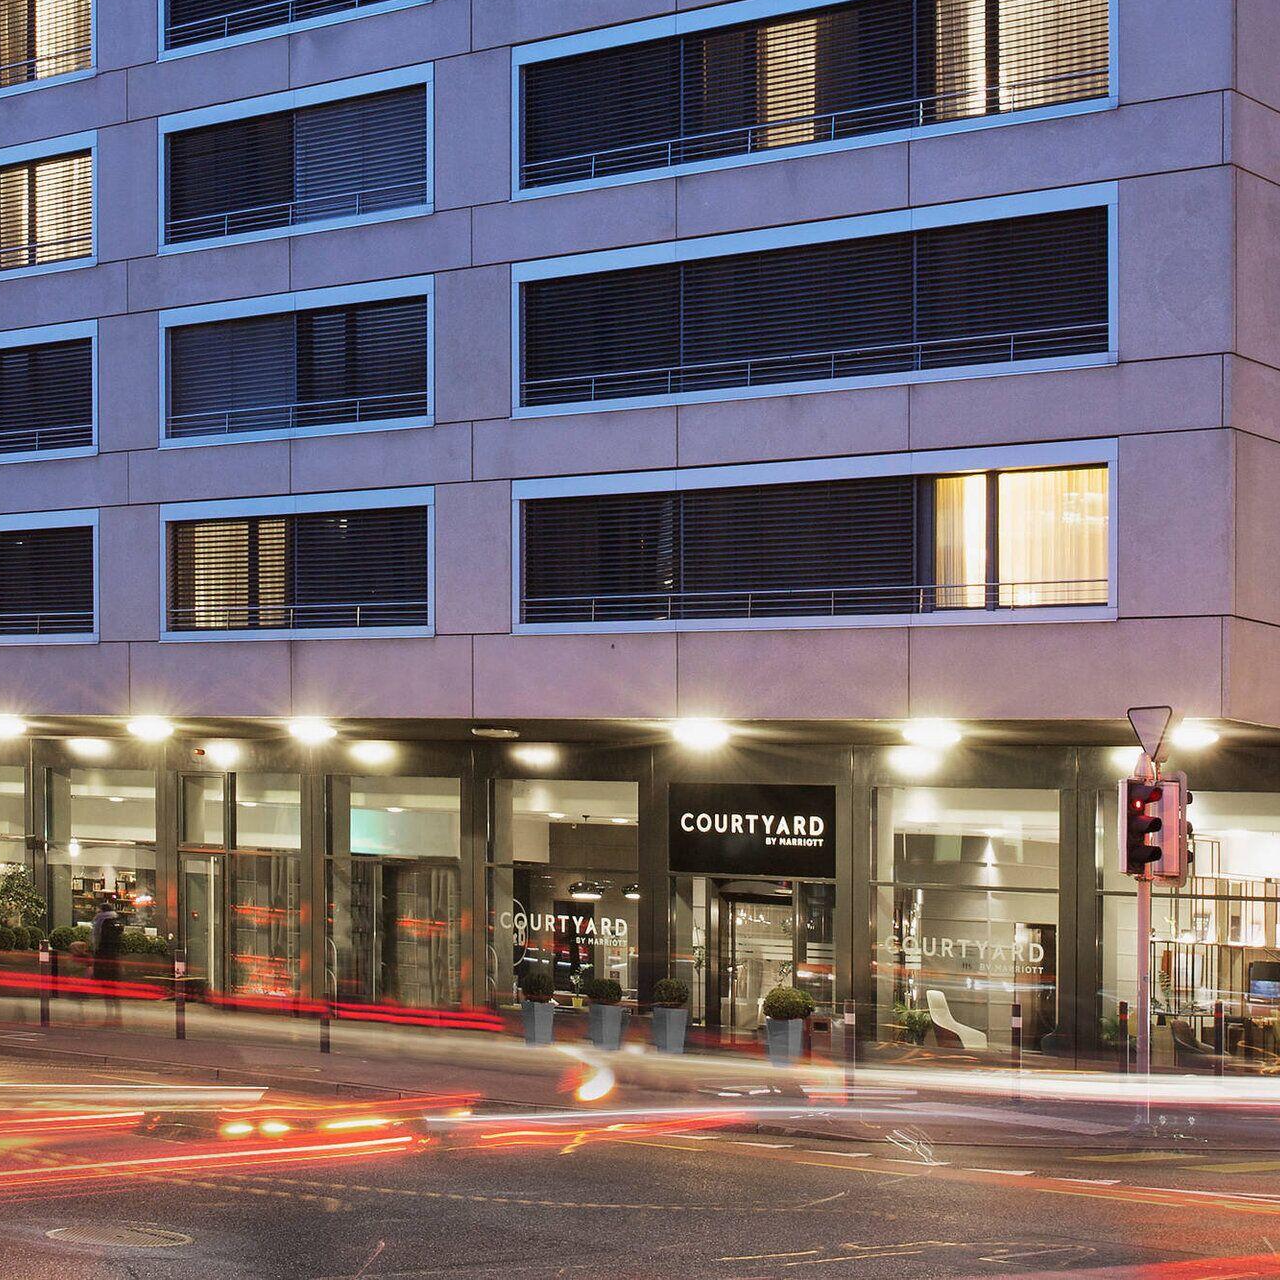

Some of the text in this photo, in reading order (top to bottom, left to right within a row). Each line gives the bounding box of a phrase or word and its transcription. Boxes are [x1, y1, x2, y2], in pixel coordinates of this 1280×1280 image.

[680, 812, 825, 836] COURTYARD
[765, 837, 824, 847] BY MARRIOTT
[500, 911, 628, 937] COURTYARD
[575, 936, 628, 947] BY MARRIOTT
[884, 934, 1045, 963] COURTYARD
